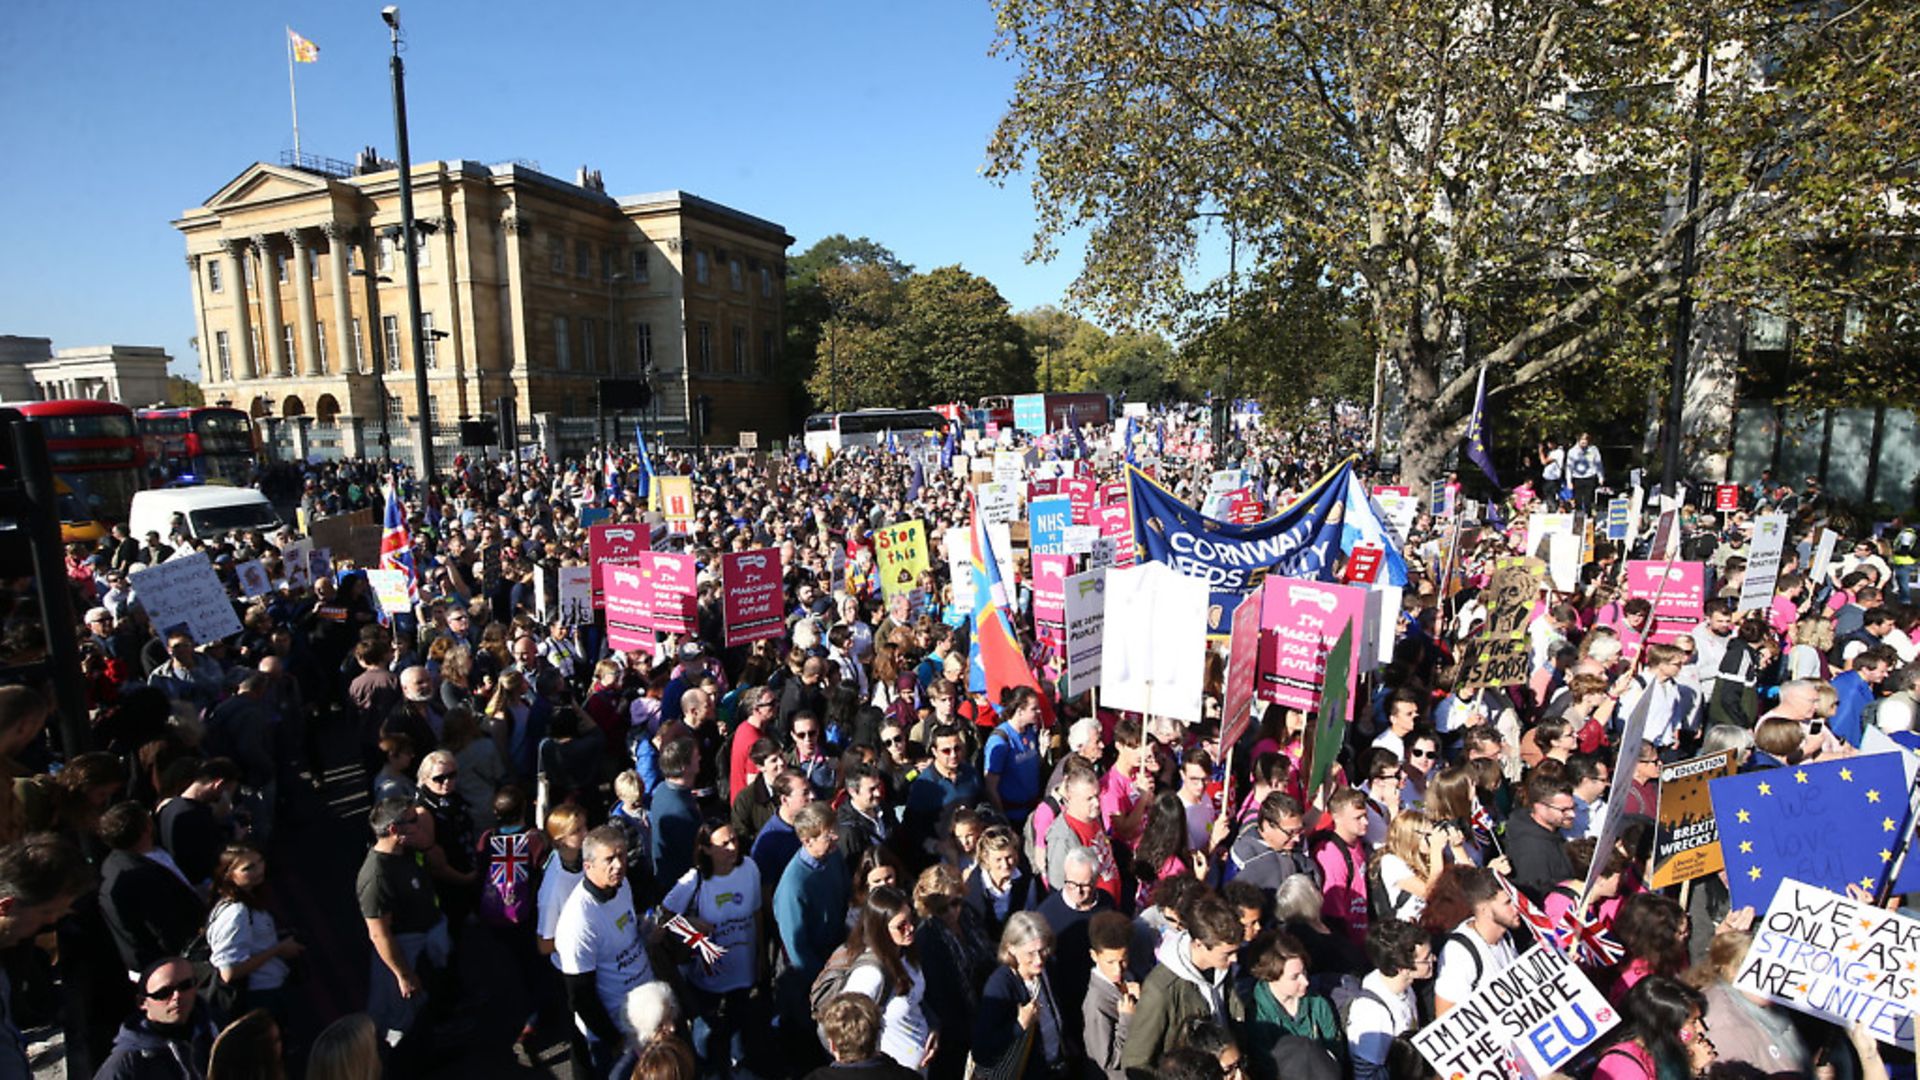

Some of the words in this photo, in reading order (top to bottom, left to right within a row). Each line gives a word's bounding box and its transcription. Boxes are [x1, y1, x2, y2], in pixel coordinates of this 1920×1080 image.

[1037, 513, 1066, 533] NHS
[1166, 554, 1245, 587] NEEDS
[1297, 613, 1324, 628] I'M
[1282, 643, 1309, 657] FOR
[1675, 756, 1726, 777] EDUCATION
[1660, 833, 1711, 857] WRECKS
[1673, 819, 1716, 840] BREXIT
[1795, 889, 1858, 927] WE
[1768, 911, 1852, 952] ONLY
[1858, 942, 1907, 972] AS
[1737, 957, 1806, 1001] ARE
[1757, 931, 1868, 986] STRONG
[1873, 974, 1915, 1000] AS
[1449, 1000, 1489, 1039] IN
[1479, 966, 1533, 1016] LOVE
[1446, 1030, 1502, 1074] THE
[1501, 972, 1581, 1038] SHAPE
[1529, 1002, 1597, 1067] EU
